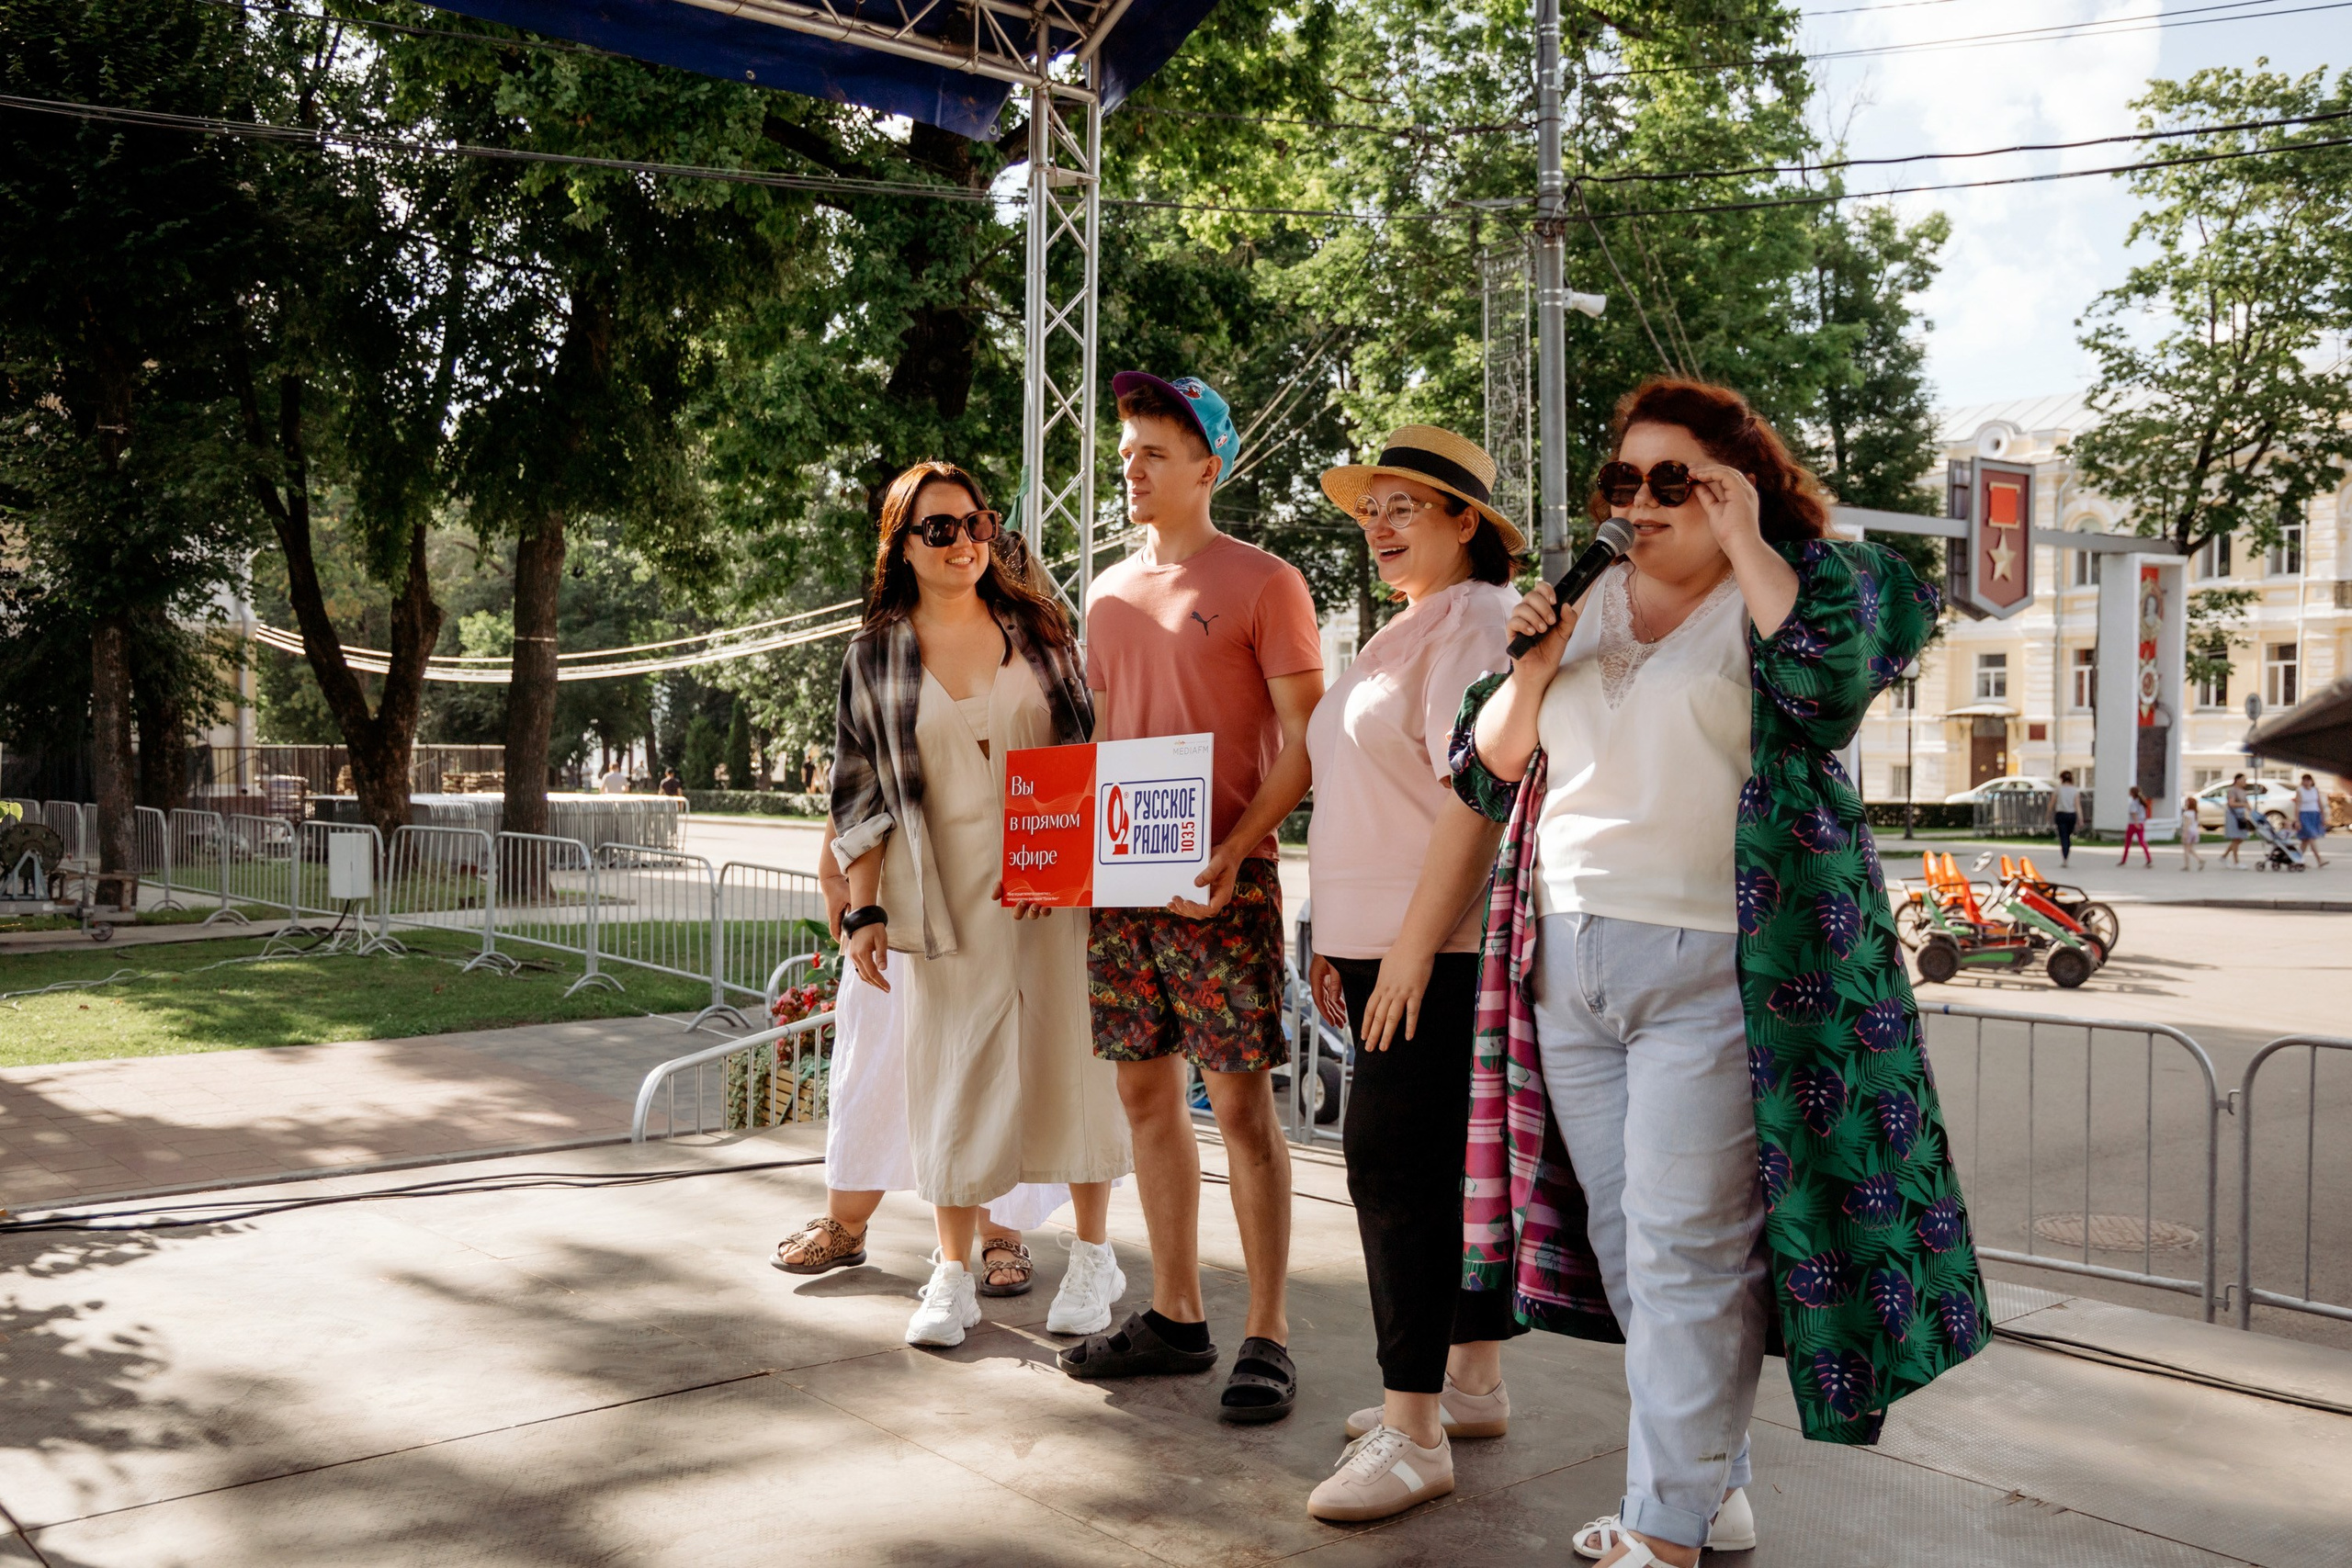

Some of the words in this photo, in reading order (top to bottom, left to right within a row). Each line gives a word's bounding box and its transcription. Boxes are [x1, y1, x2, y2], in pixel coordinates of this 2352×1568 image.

[1172, 745, 1209, 756] MEDIAFM
[1012, 775, 1034, 796] Вы
[1134, 787, 1196, 820] РУССКОЕ
[1010, 817, 1019, 831] в
[1022, 813, 1080, 836] прямом
[1181, 821, 1195, 853] 103.5
[1133, 823, 1180, 855] РАДИО
[1008, 843, 1058, 871] эфире
